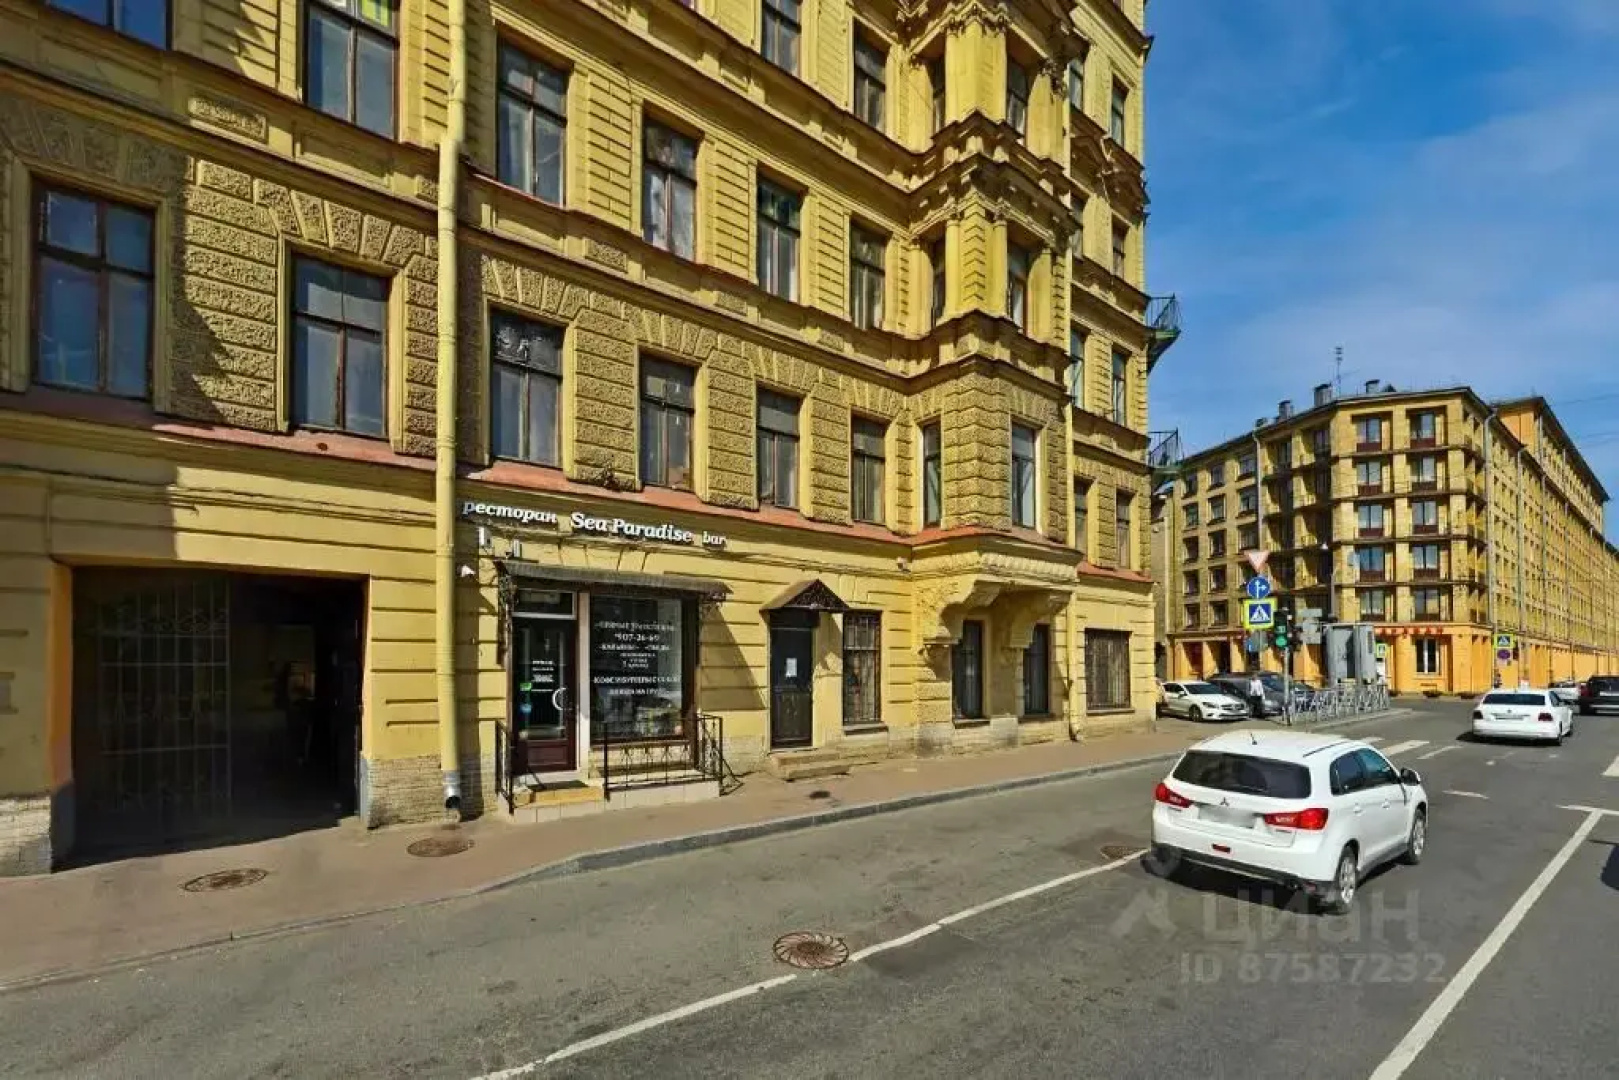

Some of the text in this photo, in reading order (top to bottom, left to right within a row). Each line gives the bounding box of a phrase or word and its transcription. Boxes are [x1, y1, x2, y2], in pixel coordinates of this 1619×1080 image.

[462, 501, 727, 545] ресторан Sea Paradise bar
